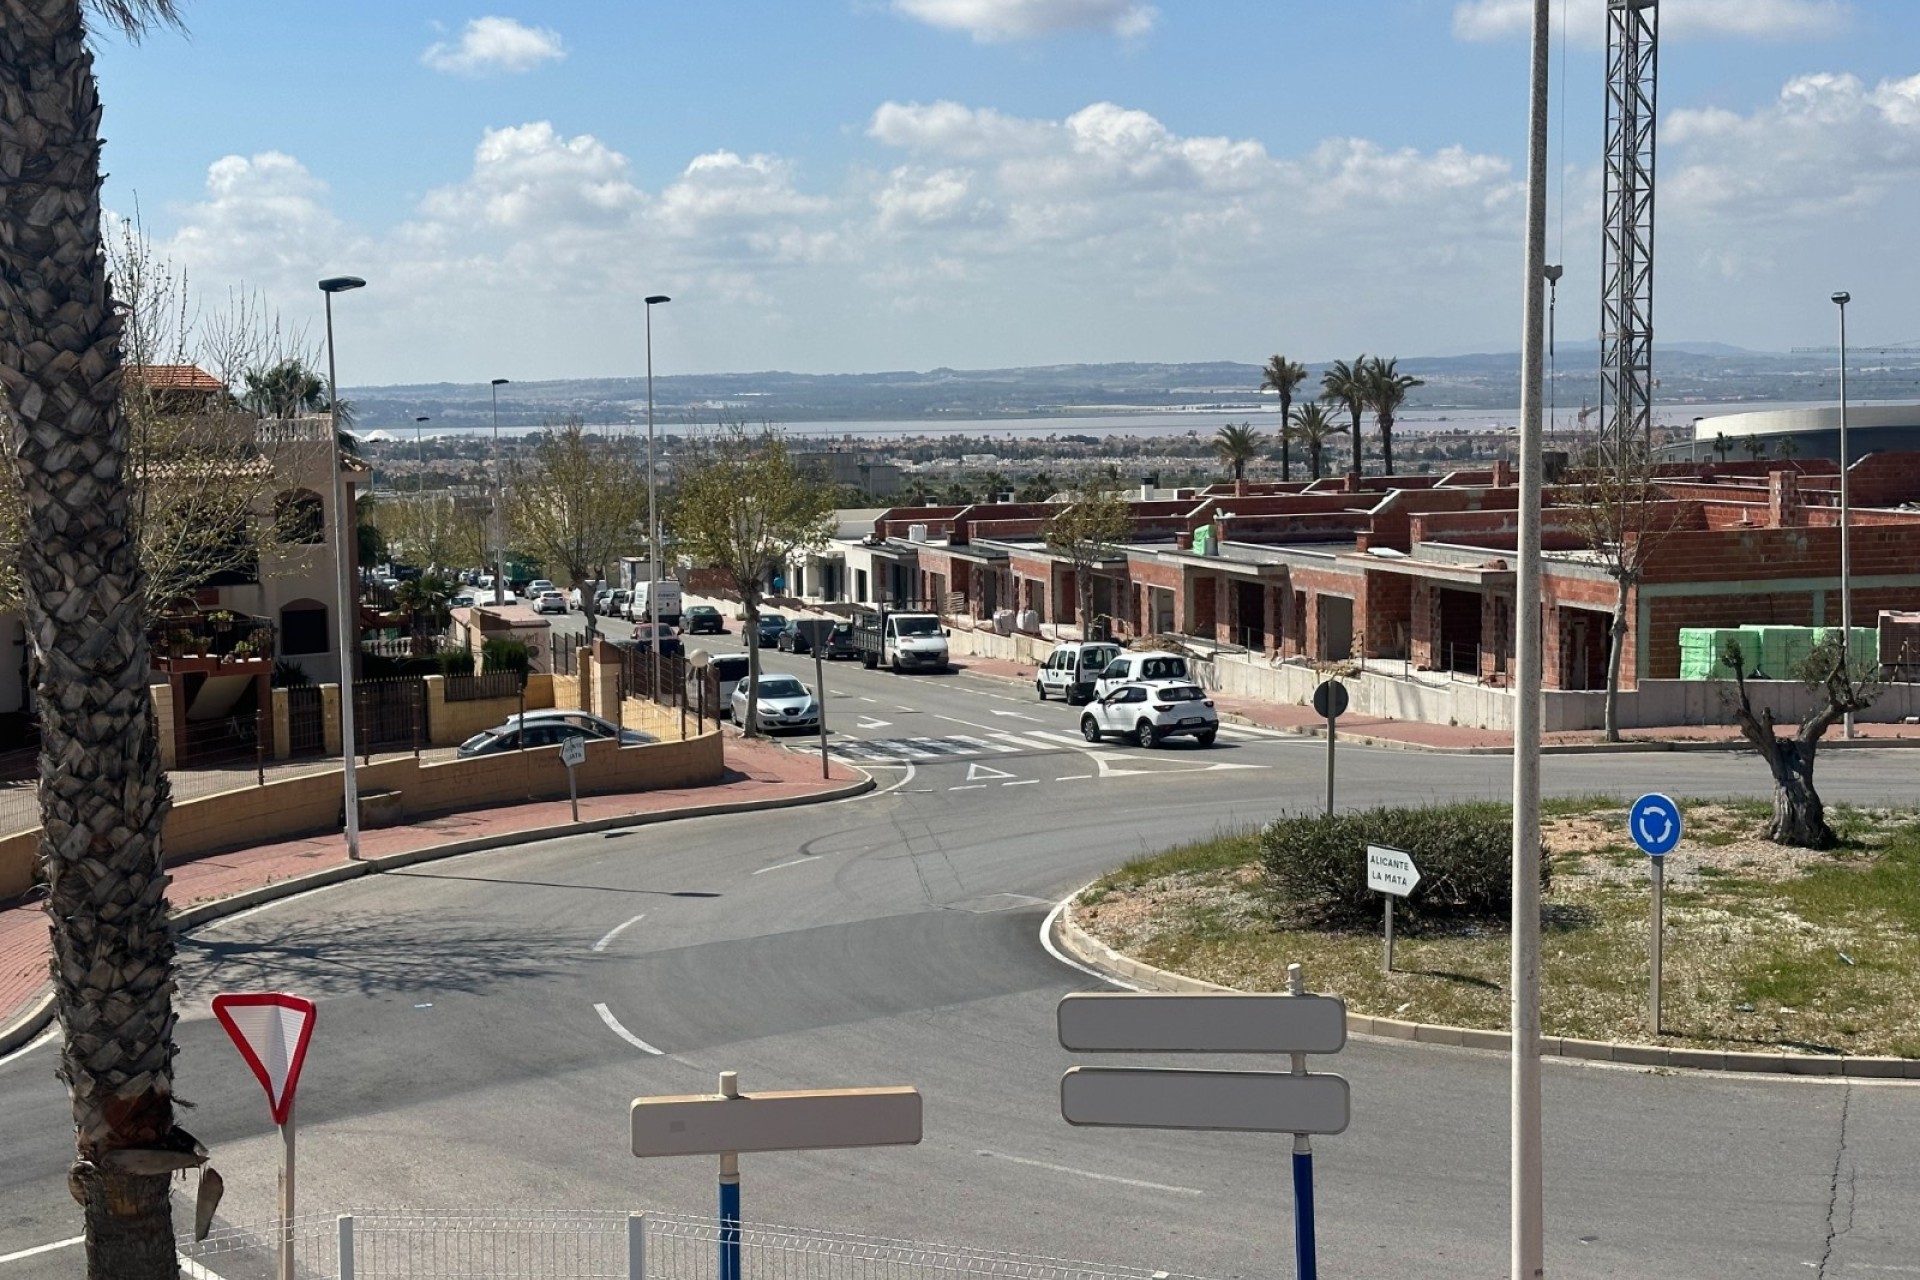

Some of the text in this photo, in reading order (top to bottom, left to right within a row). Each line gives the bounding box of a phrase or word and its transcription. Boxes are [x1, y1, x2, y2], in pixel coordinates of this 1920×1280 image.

[1370, 855, 1409, 871] ALICANTE
[1372, 870, 1407, 886] LA MATA
